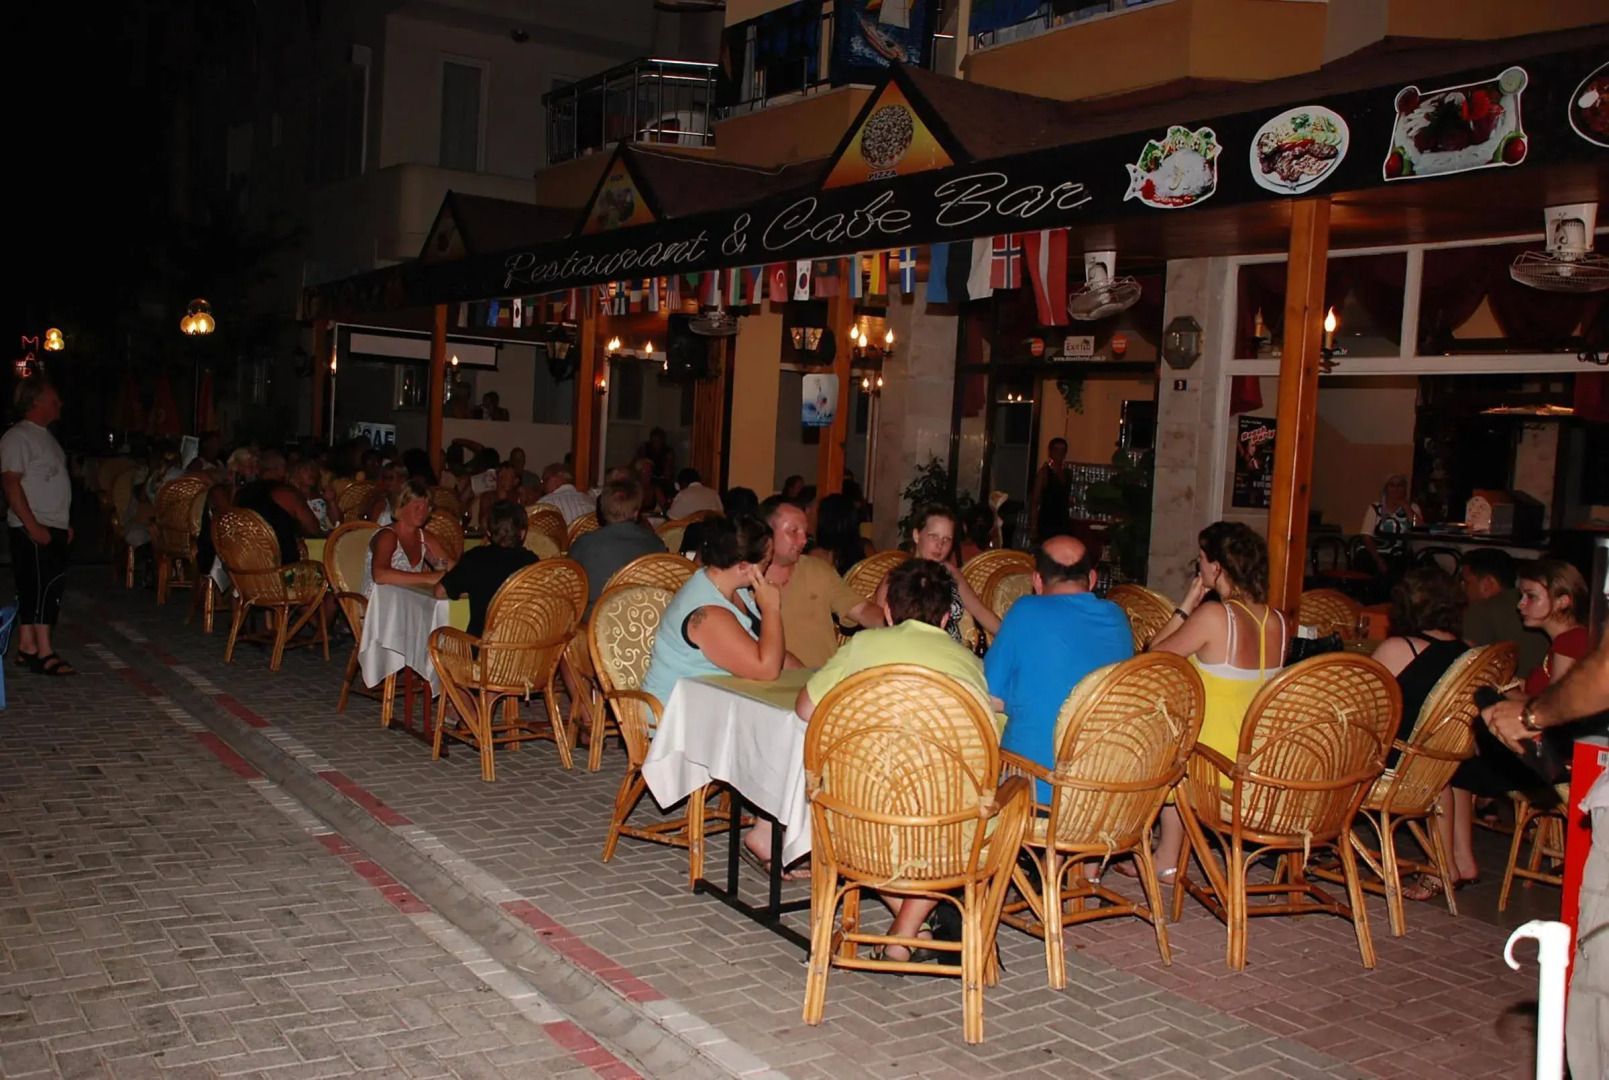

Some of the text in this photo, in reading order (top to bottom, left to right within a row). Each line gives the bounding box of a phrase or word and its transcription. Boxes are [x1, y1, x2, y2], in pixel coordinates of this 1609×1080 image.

[868, 169, 897, 180] PIZZA
[504, 172, 1093, 289] Restaurant & Cafe Bar
[1176, 380, 1184, 390] 3
